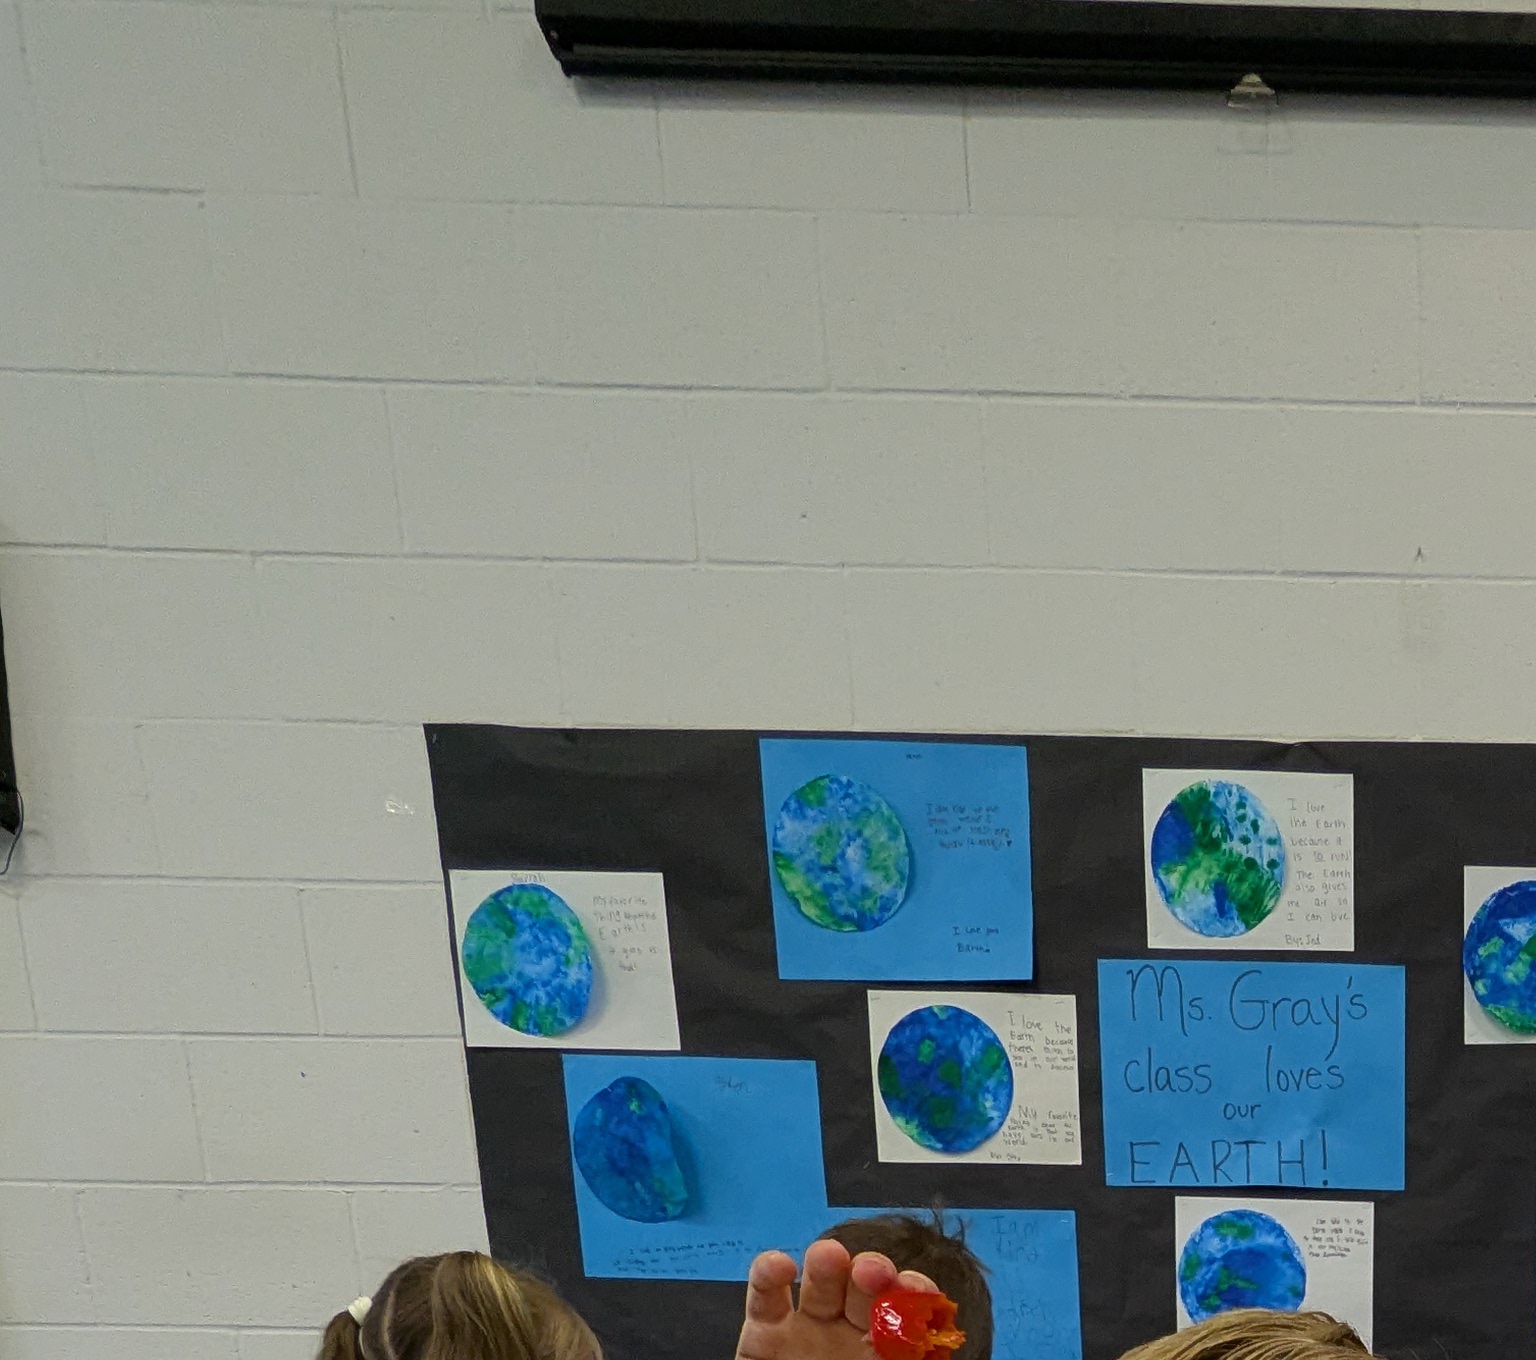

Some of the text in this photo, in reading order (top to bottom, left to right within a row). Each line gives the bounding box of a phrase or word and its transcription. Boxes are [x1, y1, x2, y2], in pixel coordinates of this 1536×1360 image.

[1307, 802, 1325, 813] love
[1316, 819, 1346, 829] Earth
[1295, 882, 1347, 895] also gives
[1125, 965, 1368, 1061] Ms. Gray's
[1021, 1014, 1043, 1031] love
[1054, 1020, 1072, 1034] the
[1123, 1046, 1346, 1095] class loves
[1018, 1104, 1079, 1121] My favorite
[1222, 1101, 1263, 1122] our
[1128, 1130, 1331, 1188] EARTH!
